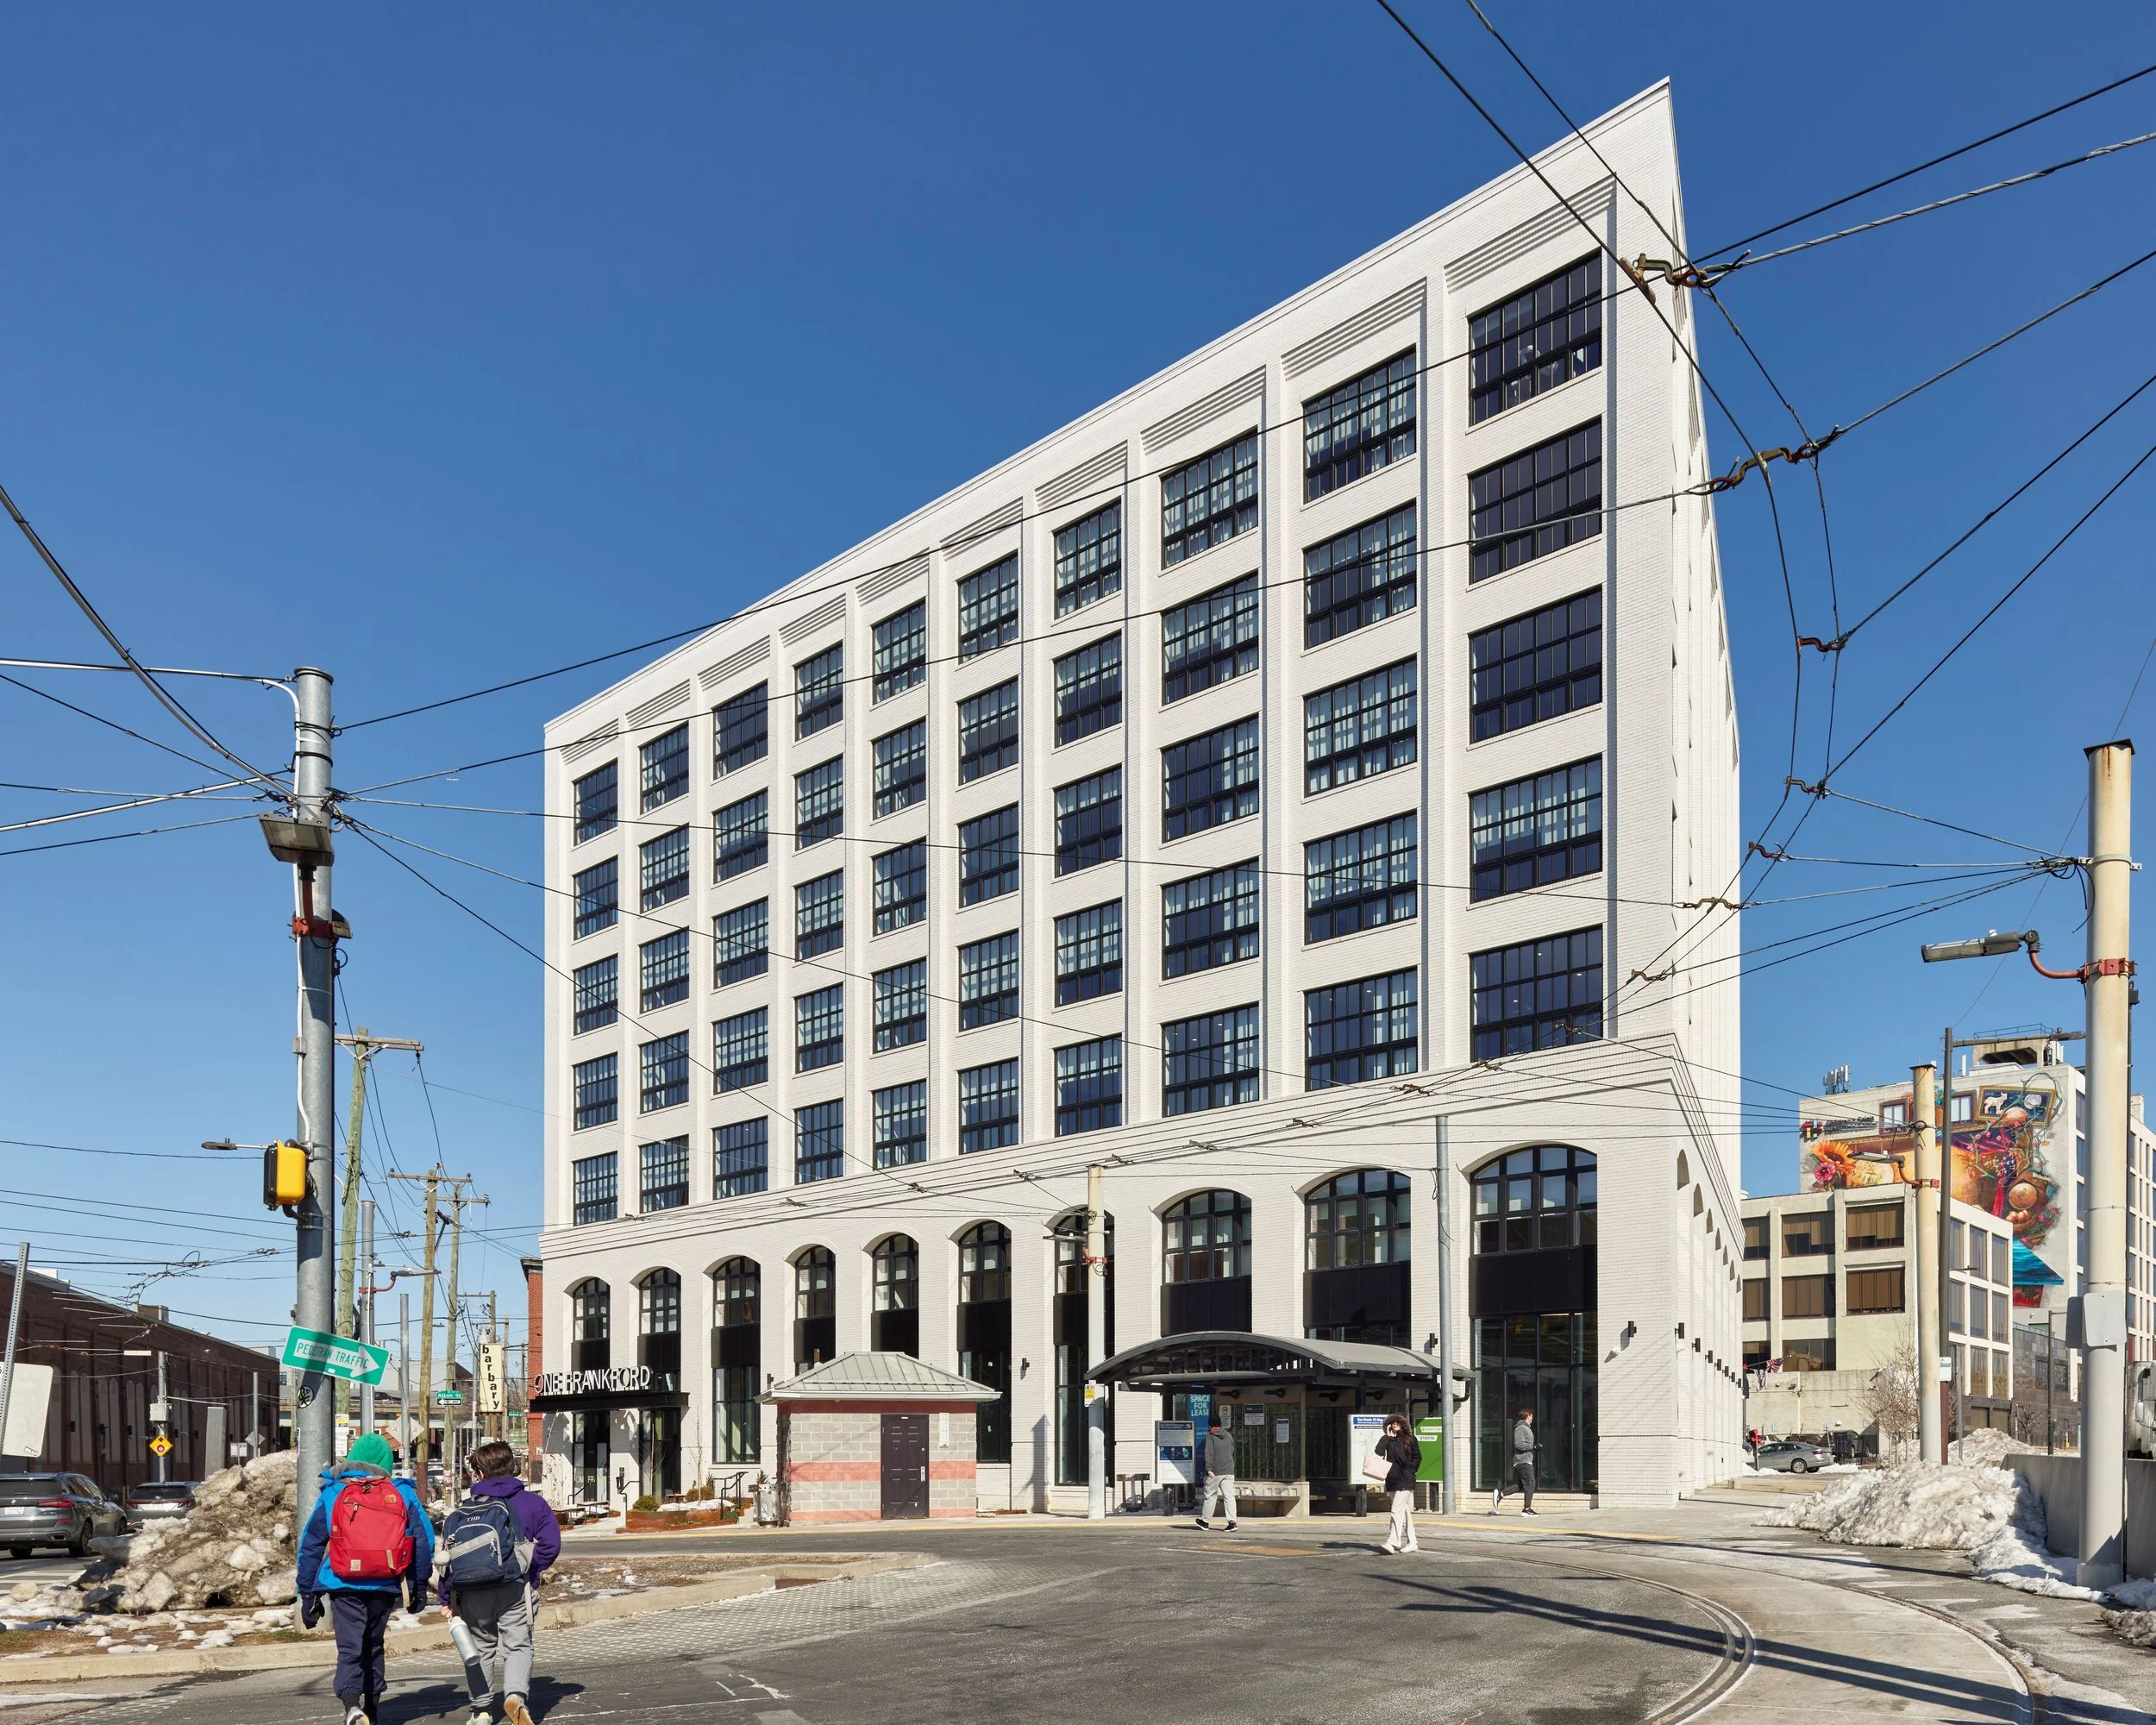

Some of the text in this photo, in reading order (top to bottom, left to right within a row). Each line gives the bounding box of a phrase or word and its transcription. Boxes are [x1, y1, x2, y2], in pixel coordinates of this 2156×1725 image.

[335, 1351, 369, 1369] TRAFFIC
[483, 1345, 499, 1409] barbary
[535, 1366, 650, 1393] ONE FRANKFORD
